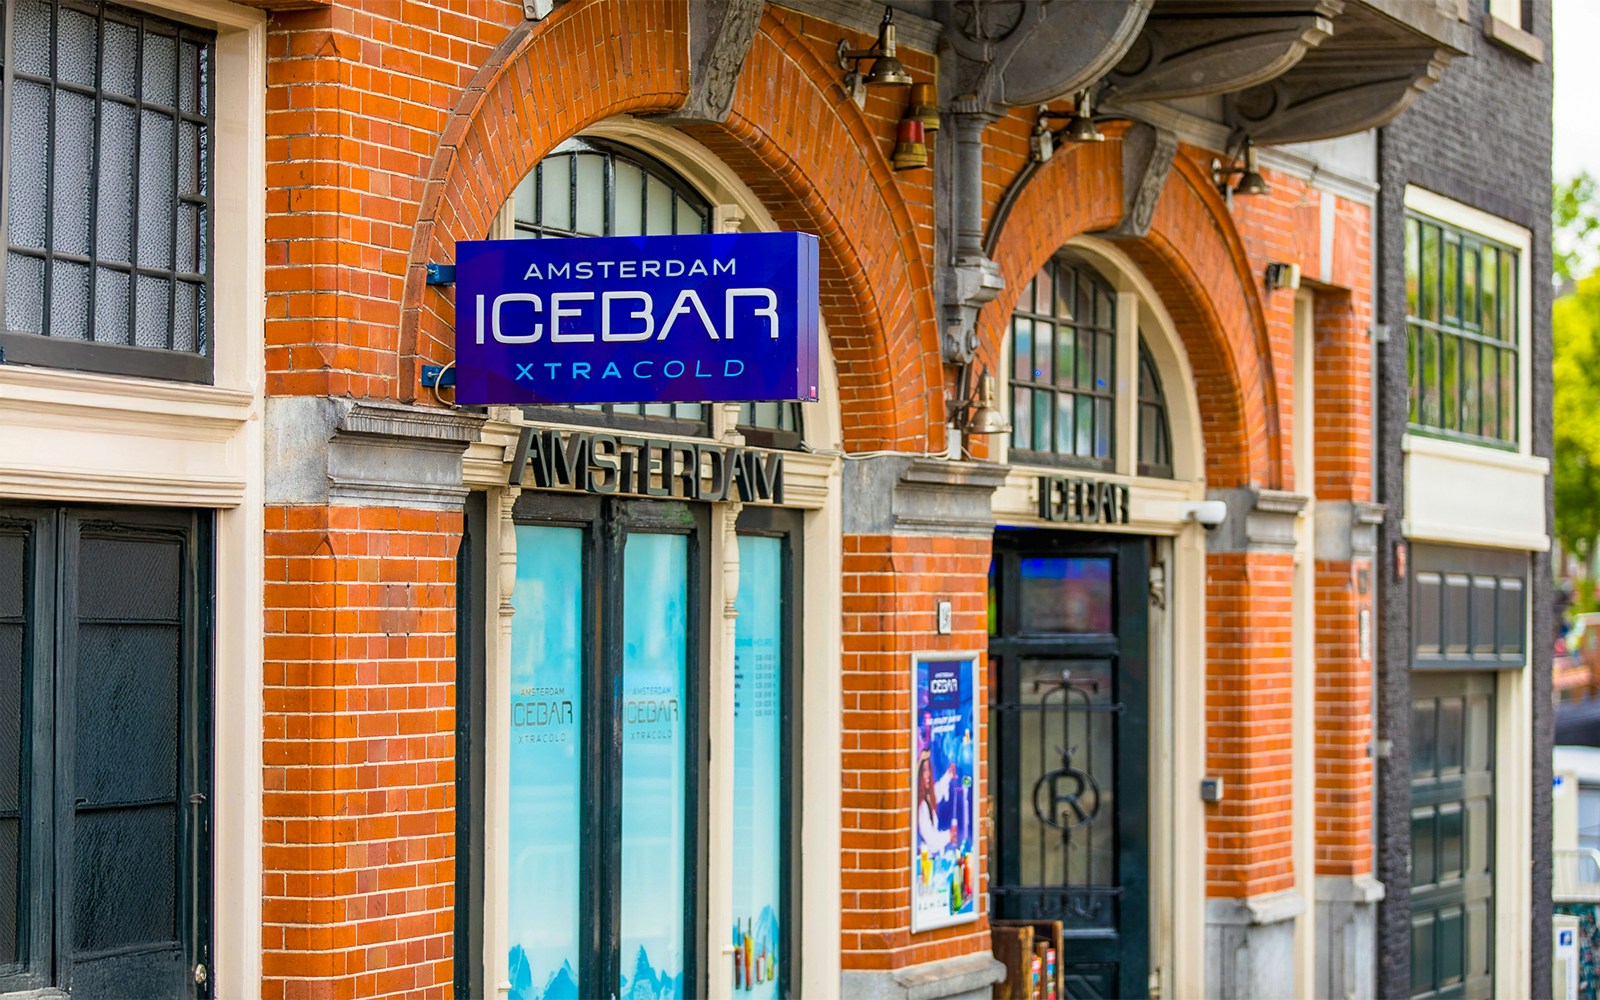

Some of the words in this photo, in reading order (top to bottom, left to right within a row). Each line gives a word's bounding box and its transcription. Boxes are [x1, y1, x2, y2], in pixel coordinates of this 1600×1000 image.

[523, 258, 736, 280] AMSTERDAM
[475, 287, 779, 345] ICEBAR
[516, 359, 745, 381] XTRACOLD
[509, 427, 784, 504] AMSTERDAM
[1039, 475, 1128, 523] ICEBAR
[520, 687, 565, 697] AMSTERDAM
[510, 700, 573, 727] ICEBAR
[518, 732, 567, 744] XTRACOLD
